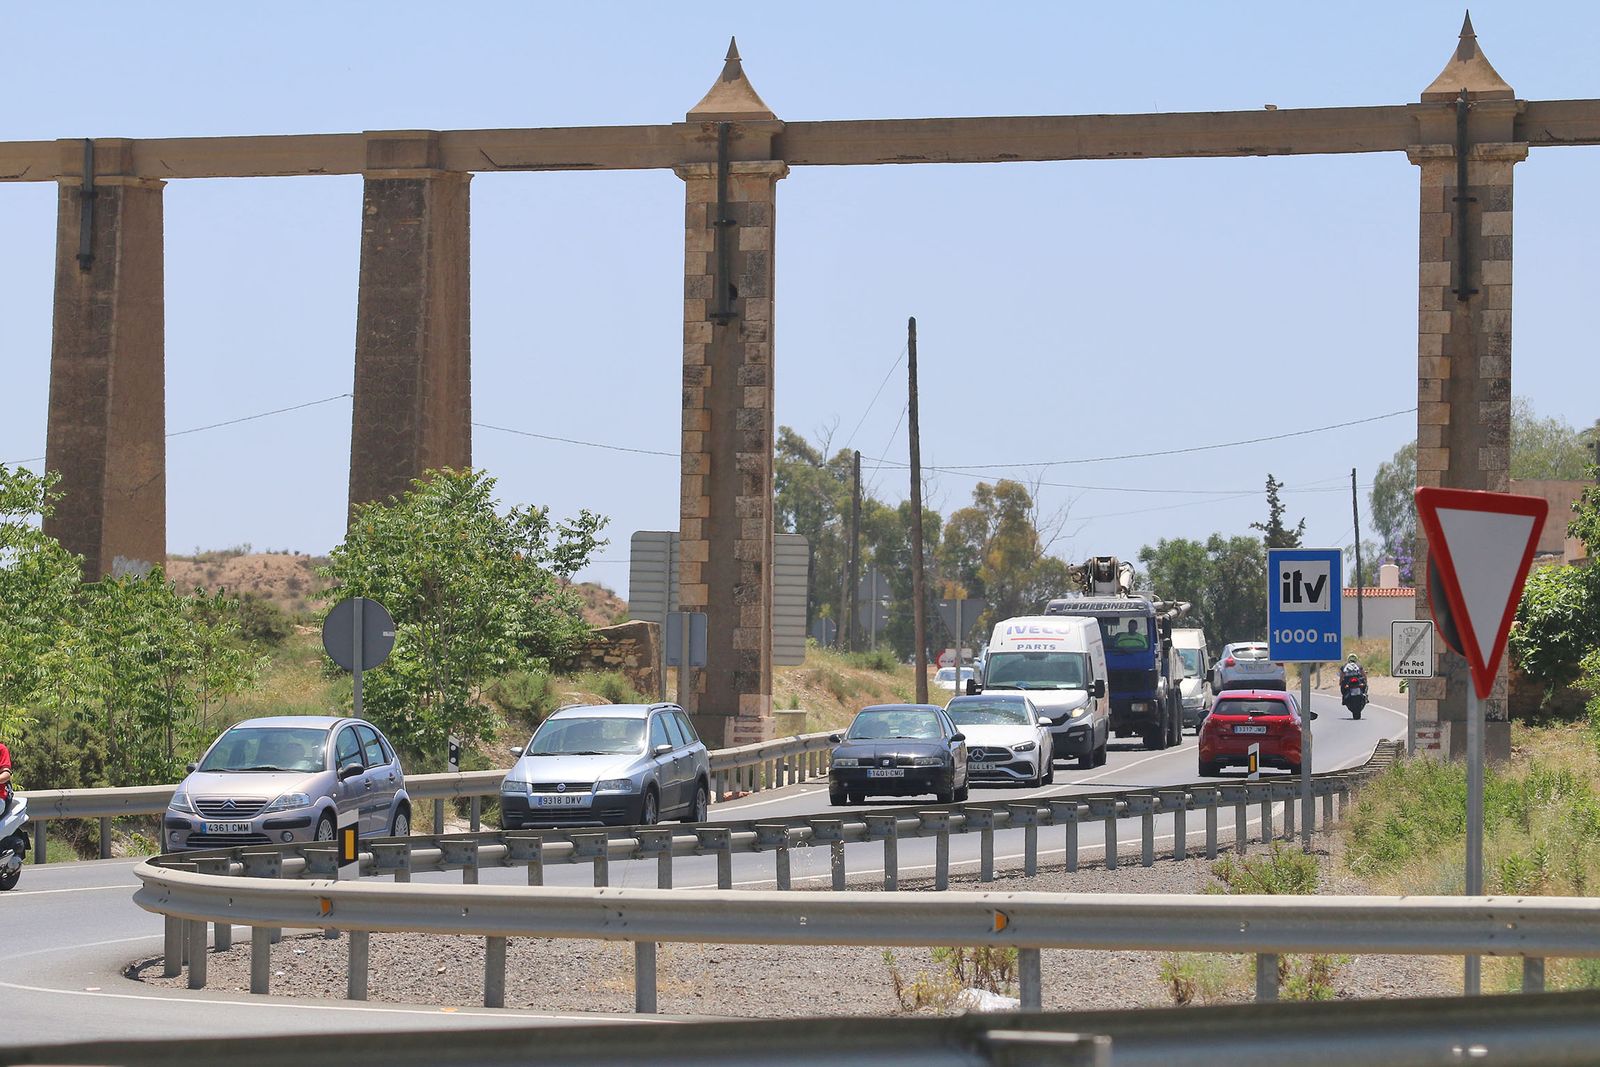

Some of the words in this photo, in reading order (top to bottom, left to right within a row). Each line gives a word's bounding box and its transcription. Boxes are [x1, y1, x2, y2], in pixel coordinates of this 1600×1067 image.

[1282, 569, 1328, 604] itv
[1006, 624, 1071, 635] IVECO
[1273, 629, 1318, 643] 1000
[1323, 632, 1338, 643] m
[543, 796, 562, 805] 9318
[208, 823, 229, 832] 4361
